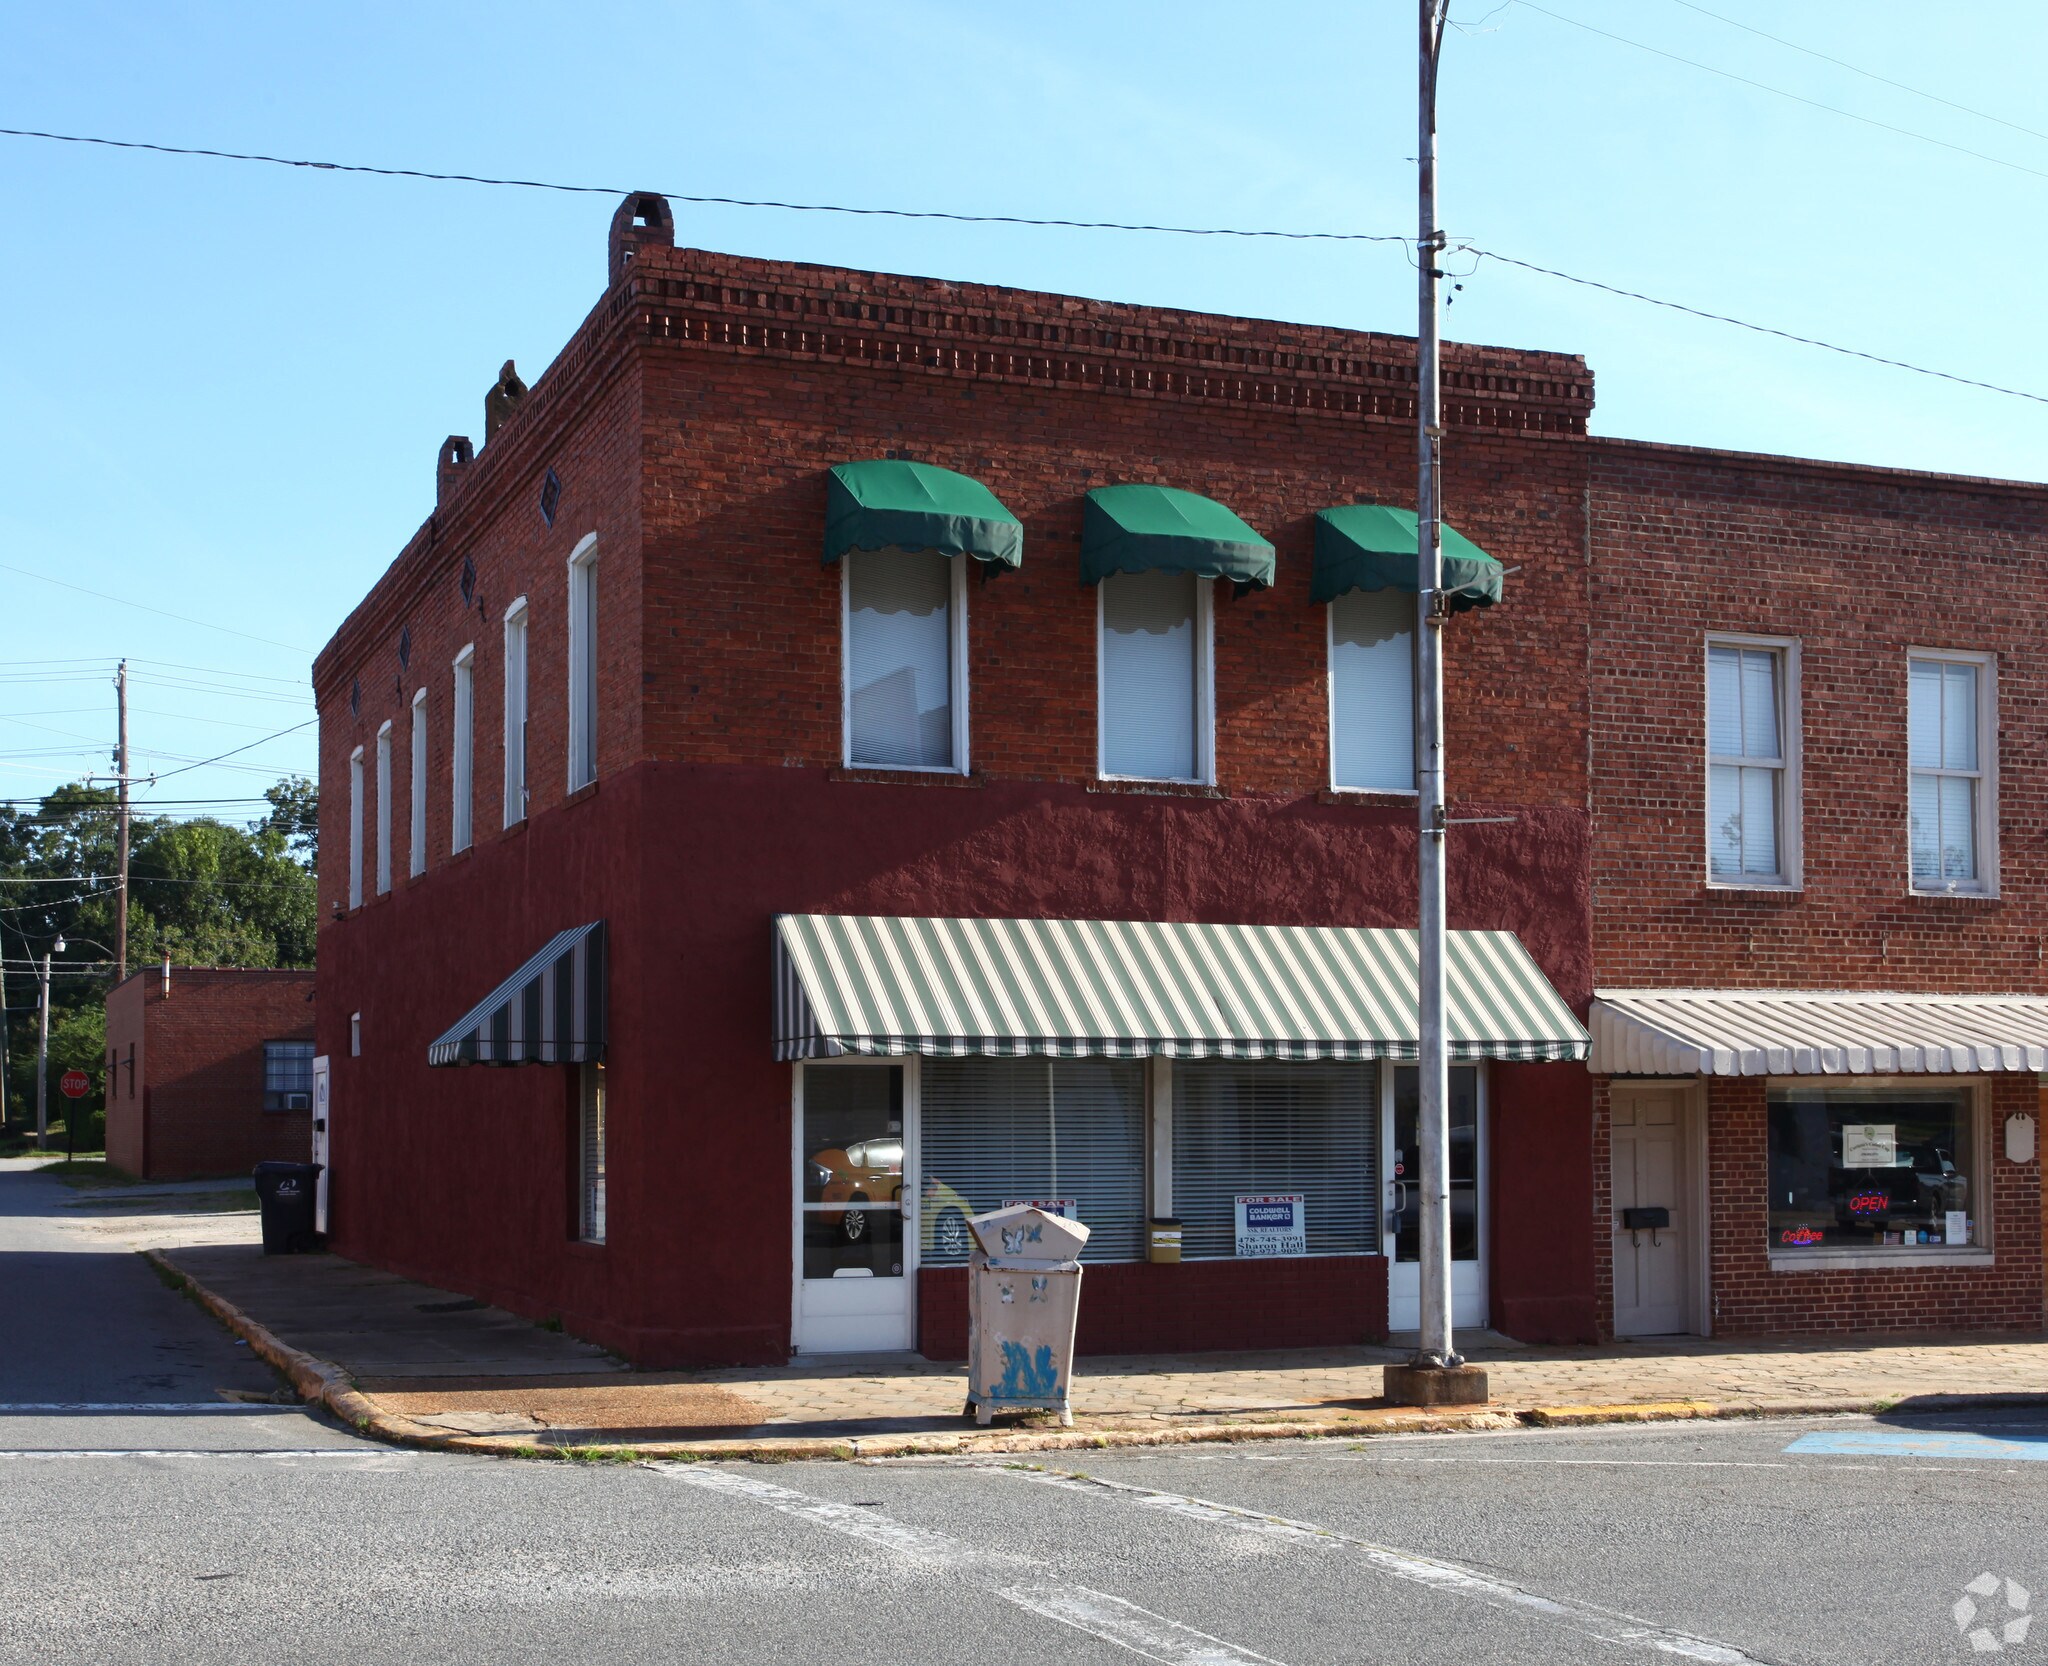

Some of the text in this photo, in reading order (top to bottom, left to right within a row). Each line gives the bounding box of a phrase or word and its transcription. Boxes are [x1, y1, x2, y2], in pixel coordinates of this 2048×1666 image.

[63, 1079, 88, 1089] STOP
[1850, 1196, 1889, 1210] OPEN
[1781, 1229, 1823, 1243] Coffee
